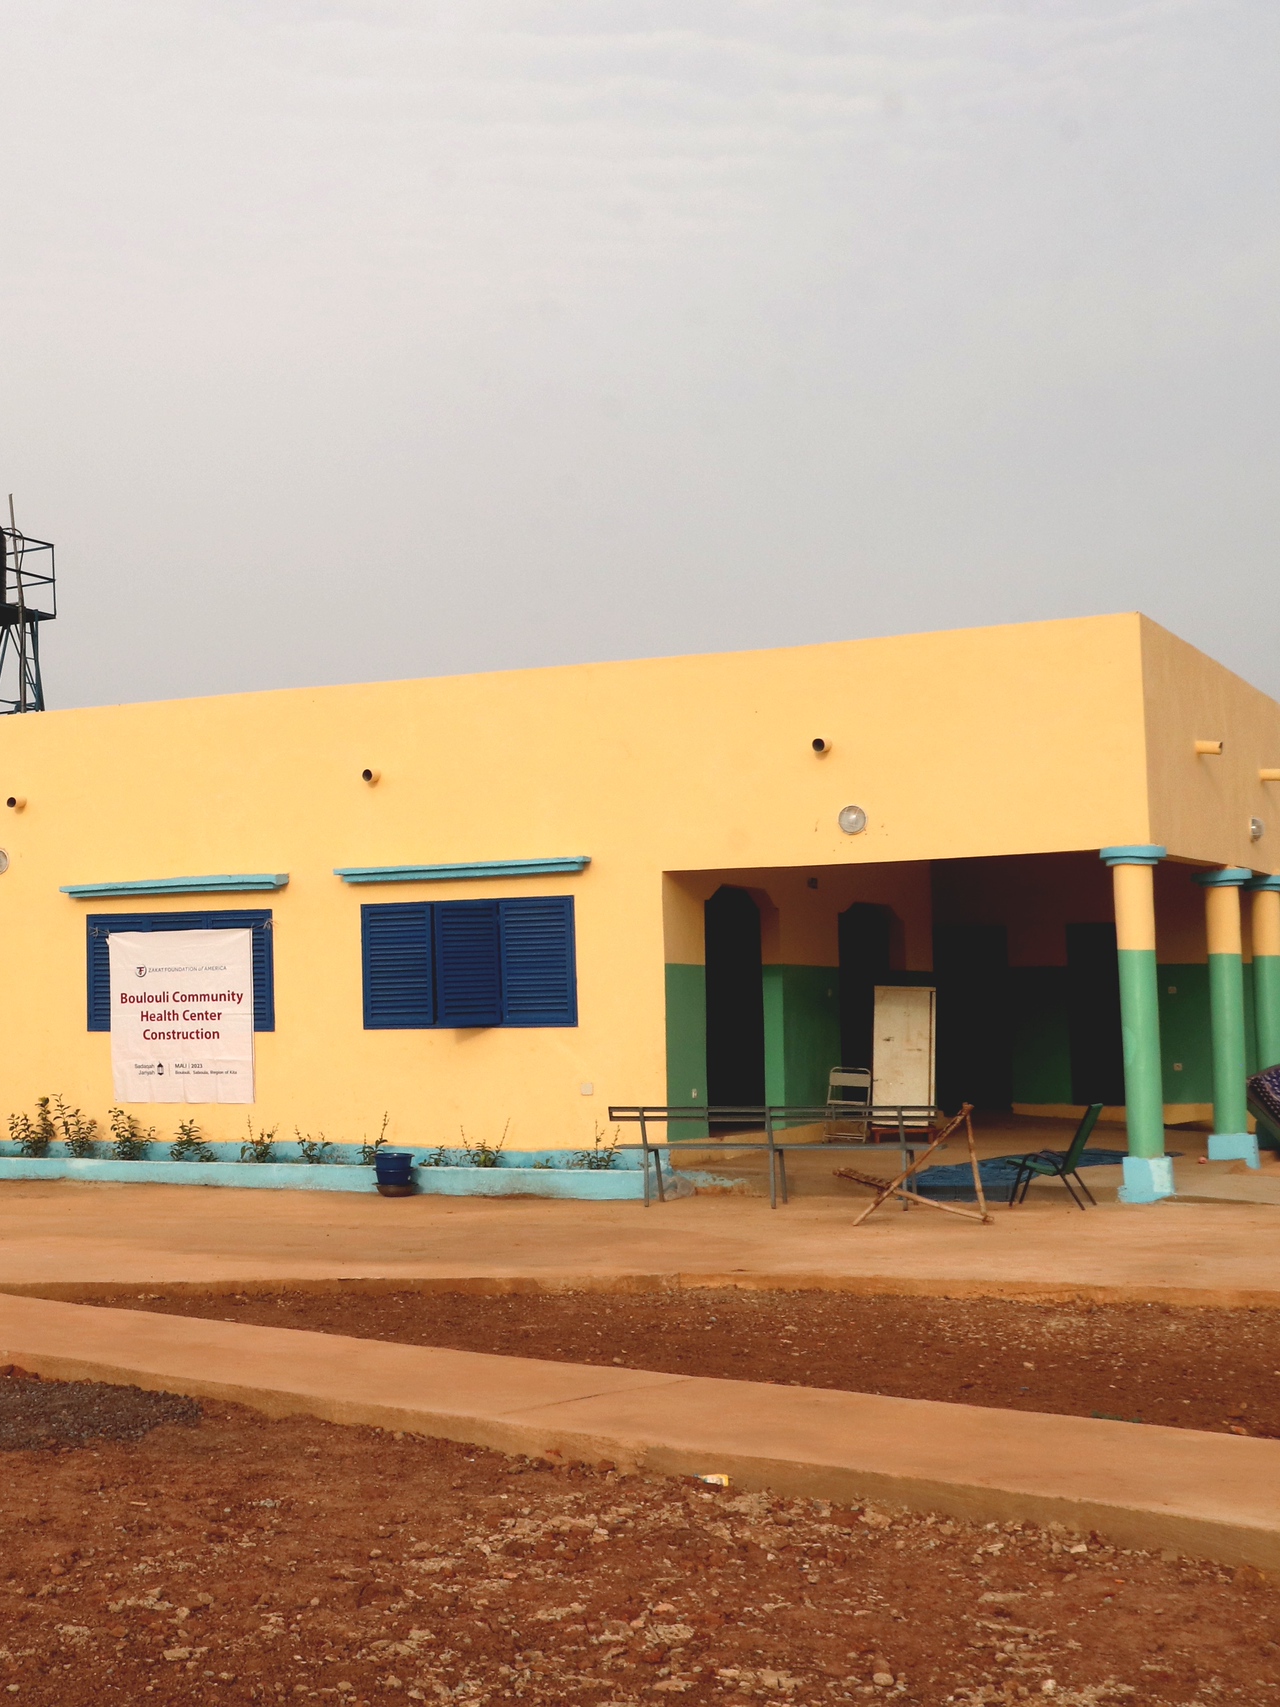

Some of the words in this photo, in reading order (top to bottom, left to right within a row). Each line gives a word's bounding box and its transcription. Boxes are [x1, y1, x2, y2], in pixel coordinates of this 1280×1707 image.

[120, 991, 169, 1004] Boulouli
[172, 990, 244, 1005] Community
[140, 1009, 179, 1022] Health
[182, 1009, 222, 1021] Center
[142, 1028, 220, 1040] Construction
